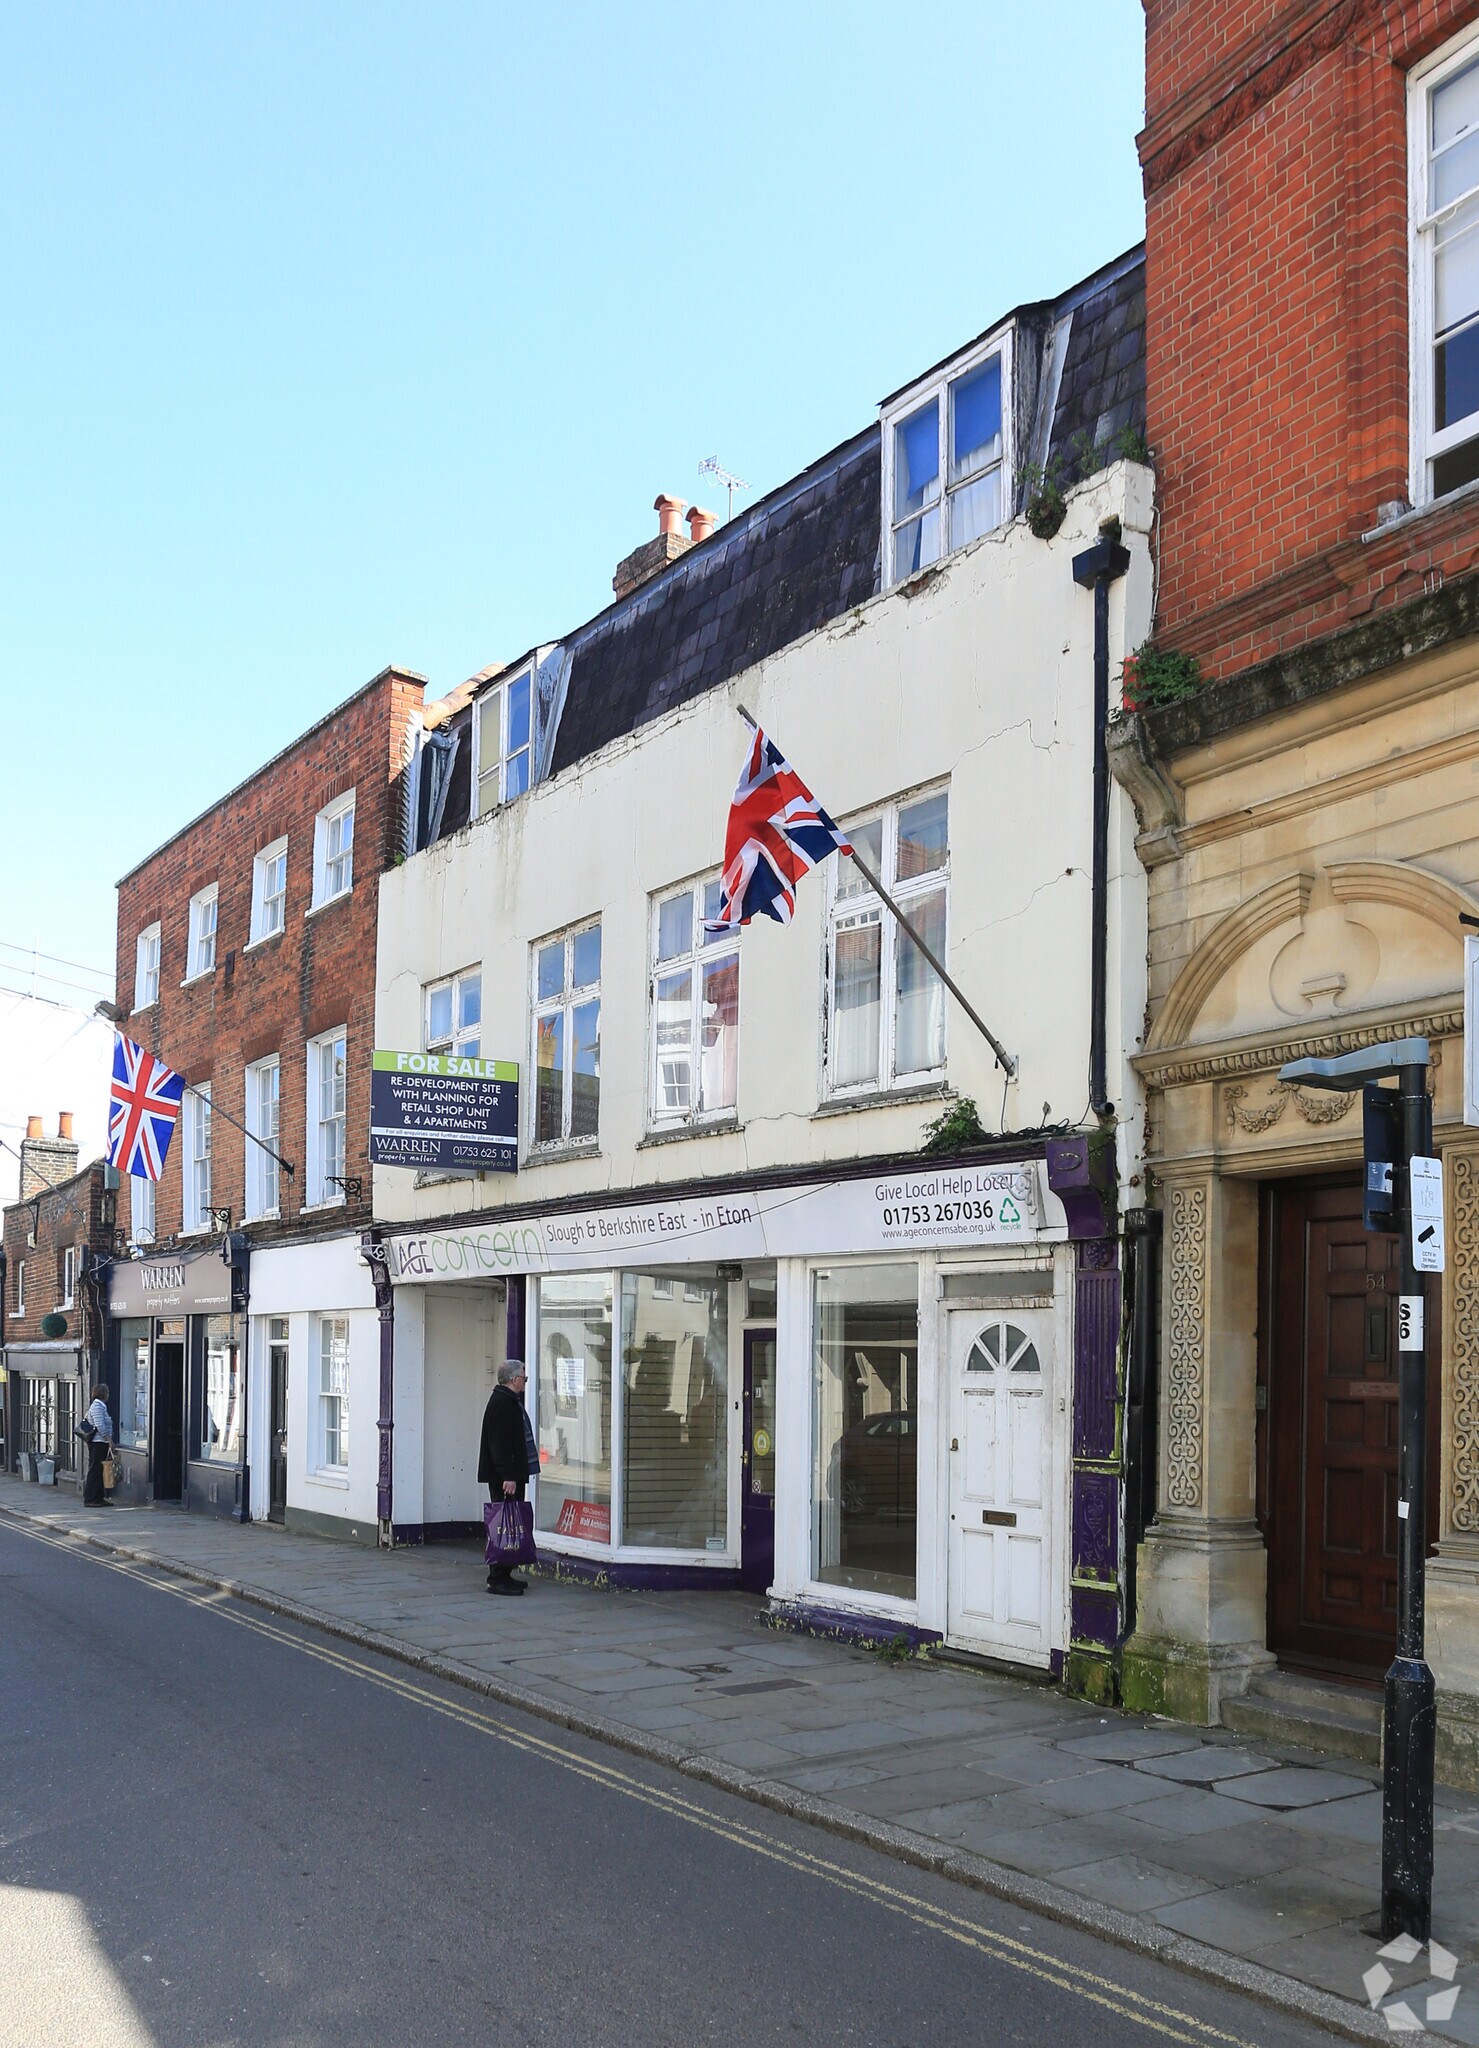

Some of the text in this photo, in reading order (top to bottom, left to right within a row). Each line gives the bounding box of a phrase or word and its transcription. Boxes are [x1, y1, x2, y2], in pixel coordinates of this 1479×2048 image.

[397, 1054, 496, 1078] FOR SALE
[390, 1076, 501, 1094] RE-DEVELOPMENT SITE
[393, 1089, 499, 1106] WITH PLANNING FOR
[401, 1102, 491, 1118] RETAIL SHOP UNIT
[404, 1115, 488, 1130] & 4 APARTMENTS
[375, 1137, 441, 1153] WARREN
[453, 1146, 512, 1159] 01753 625 101
[378, 1154, 406, 1164] property
[875, 1185, 903, 1201] Give
[906, 1178, 939, 1198] Local
[943, 1175, 973, 1198] Help
[884, 1200, 993, 1226] 01753 267036
[547, 1222, 585, 1245] Slough
[587, 1220, 597, 1238] &
[598, 1215, 656, 1237] Berkshire
[658, 1213, 687, 1231] East
[700, 1208, 715, 1228] in
[717, 1206, 752, 1226] Eton
[882, 1221, 997, 1240] www.ageconcernsabe.org.uk
[1001, 1223, 1021, 1232] recycle
[141, 1265, 183, 1290] WARREN
[1366, 1273, 1387, 1291] 54
[1400, 1303, 1411, 1321] S
[1400, 1322, 1411, 1339] 6
